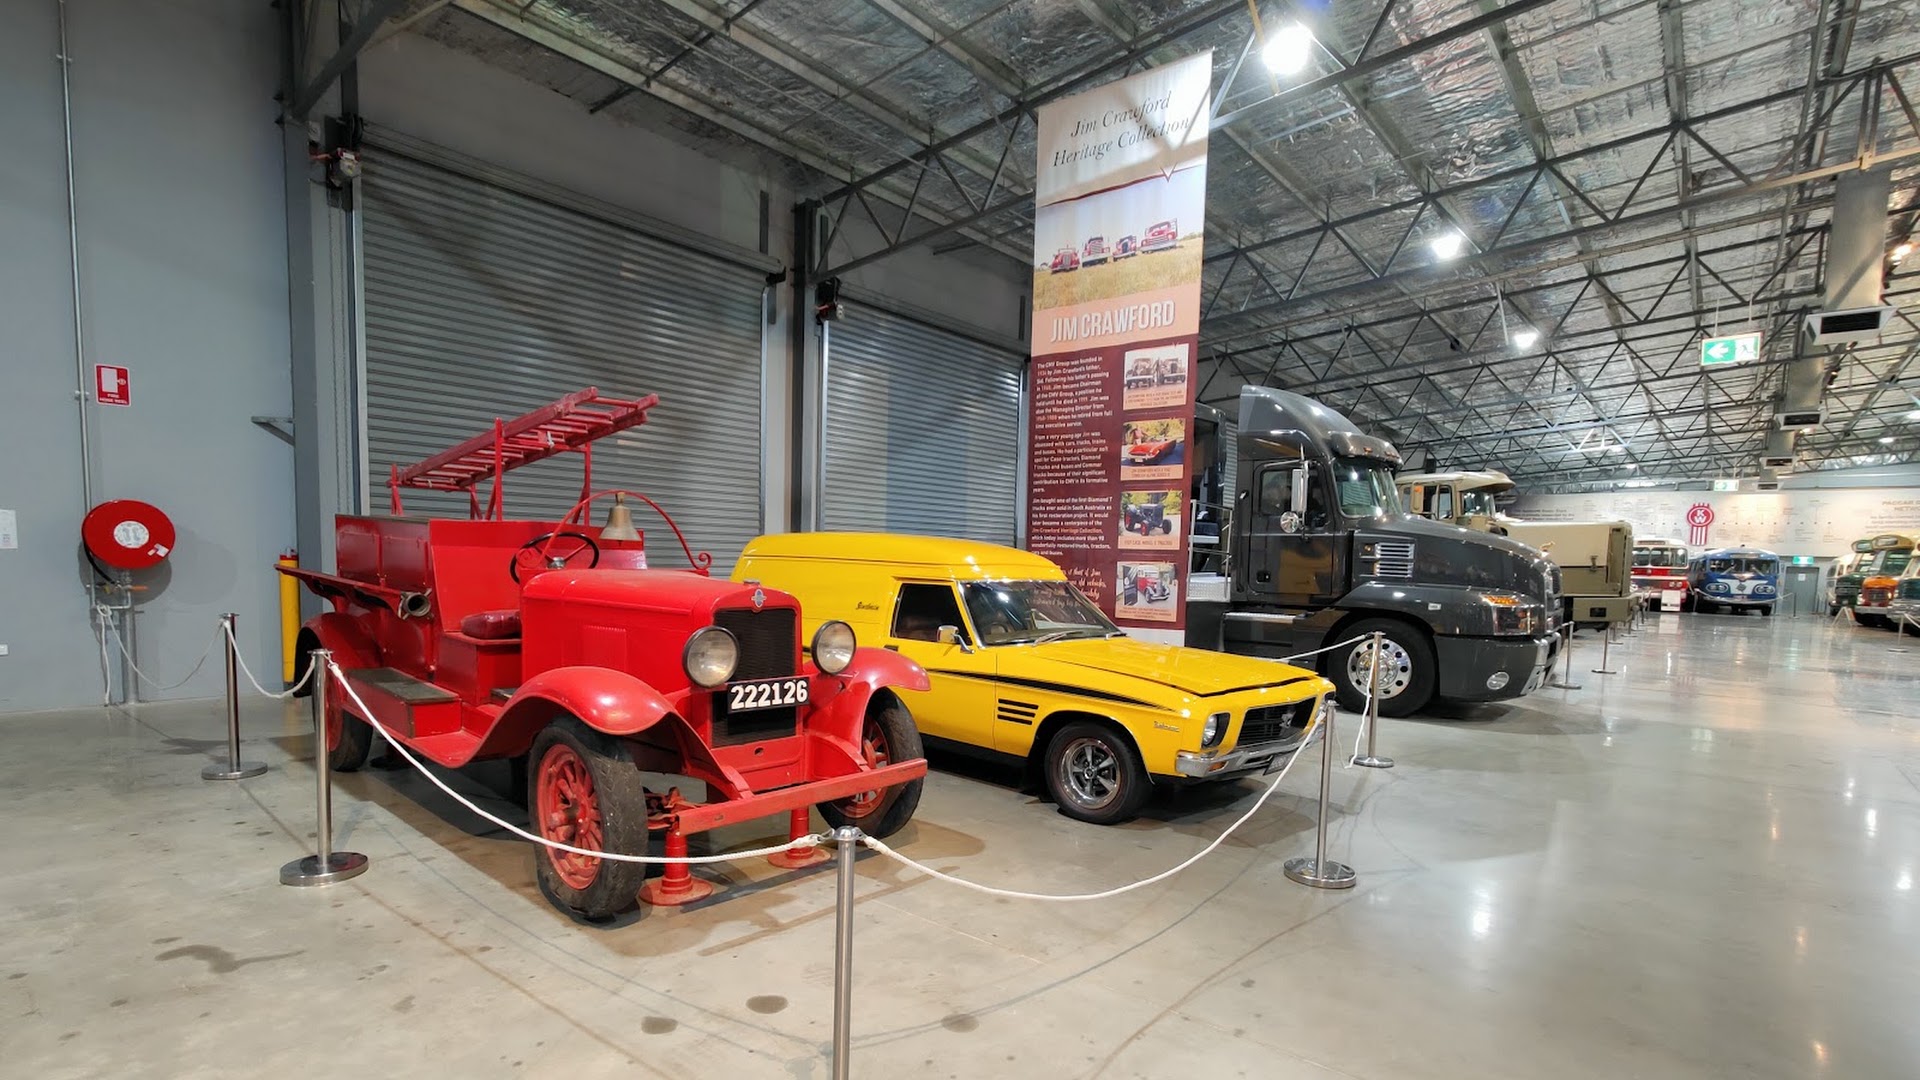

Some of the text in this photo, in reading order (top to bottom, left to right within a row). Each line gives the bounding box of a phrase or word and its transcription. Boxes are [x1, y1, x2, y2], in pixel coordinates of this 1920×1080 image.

[1071, 90, 1172, 137] Jim Crawford
[1053, 118, 1189, 167] Heritage Collection
[1050, 300, 1175, 342] JIM CRAWFORD
[731, 680, 808, 710] 222126
